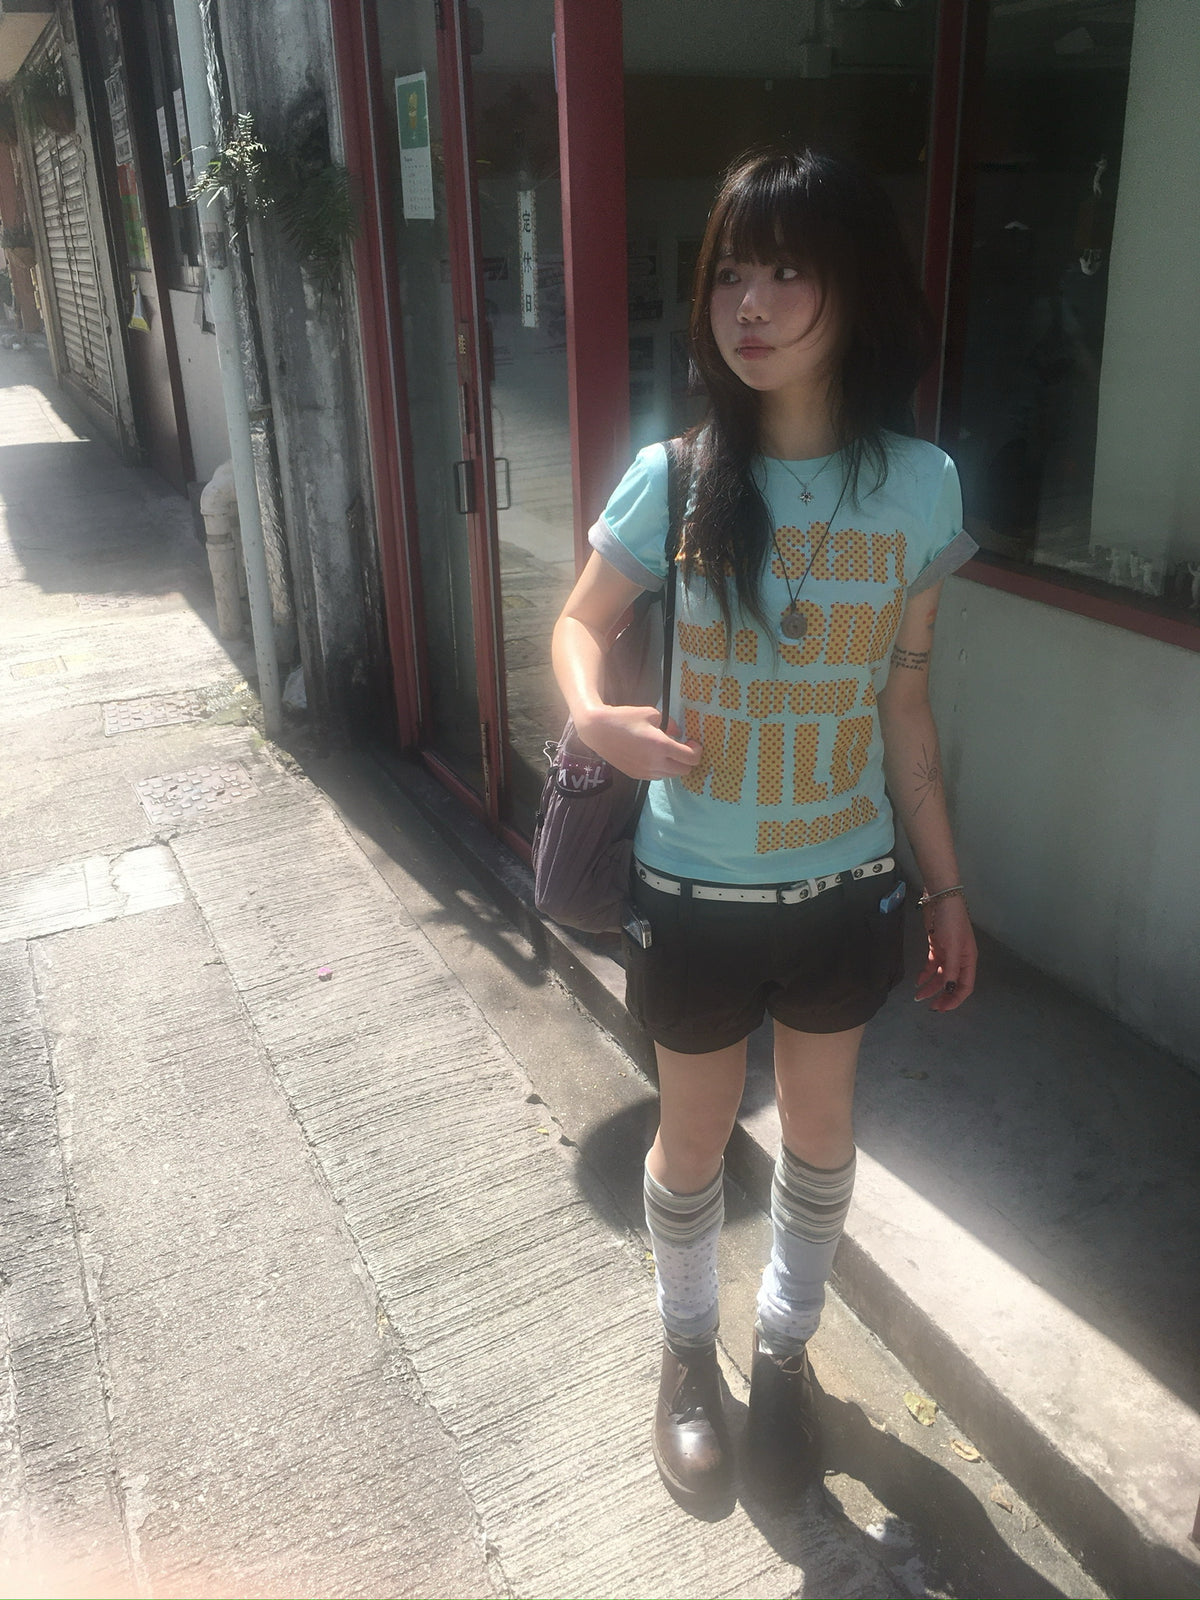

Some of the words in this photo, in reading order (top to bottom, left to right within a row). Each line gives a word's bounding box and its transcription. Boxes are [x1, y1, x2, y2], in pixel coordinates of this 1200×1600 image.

[771, 520, 908, 587] start
[735, 628, 759, 666] a
[778, 587, 904, 668] end
[718, 675, 742, 711] a
[746, 677, 859, 720] group
[680, 707, 874, 806] WILD
